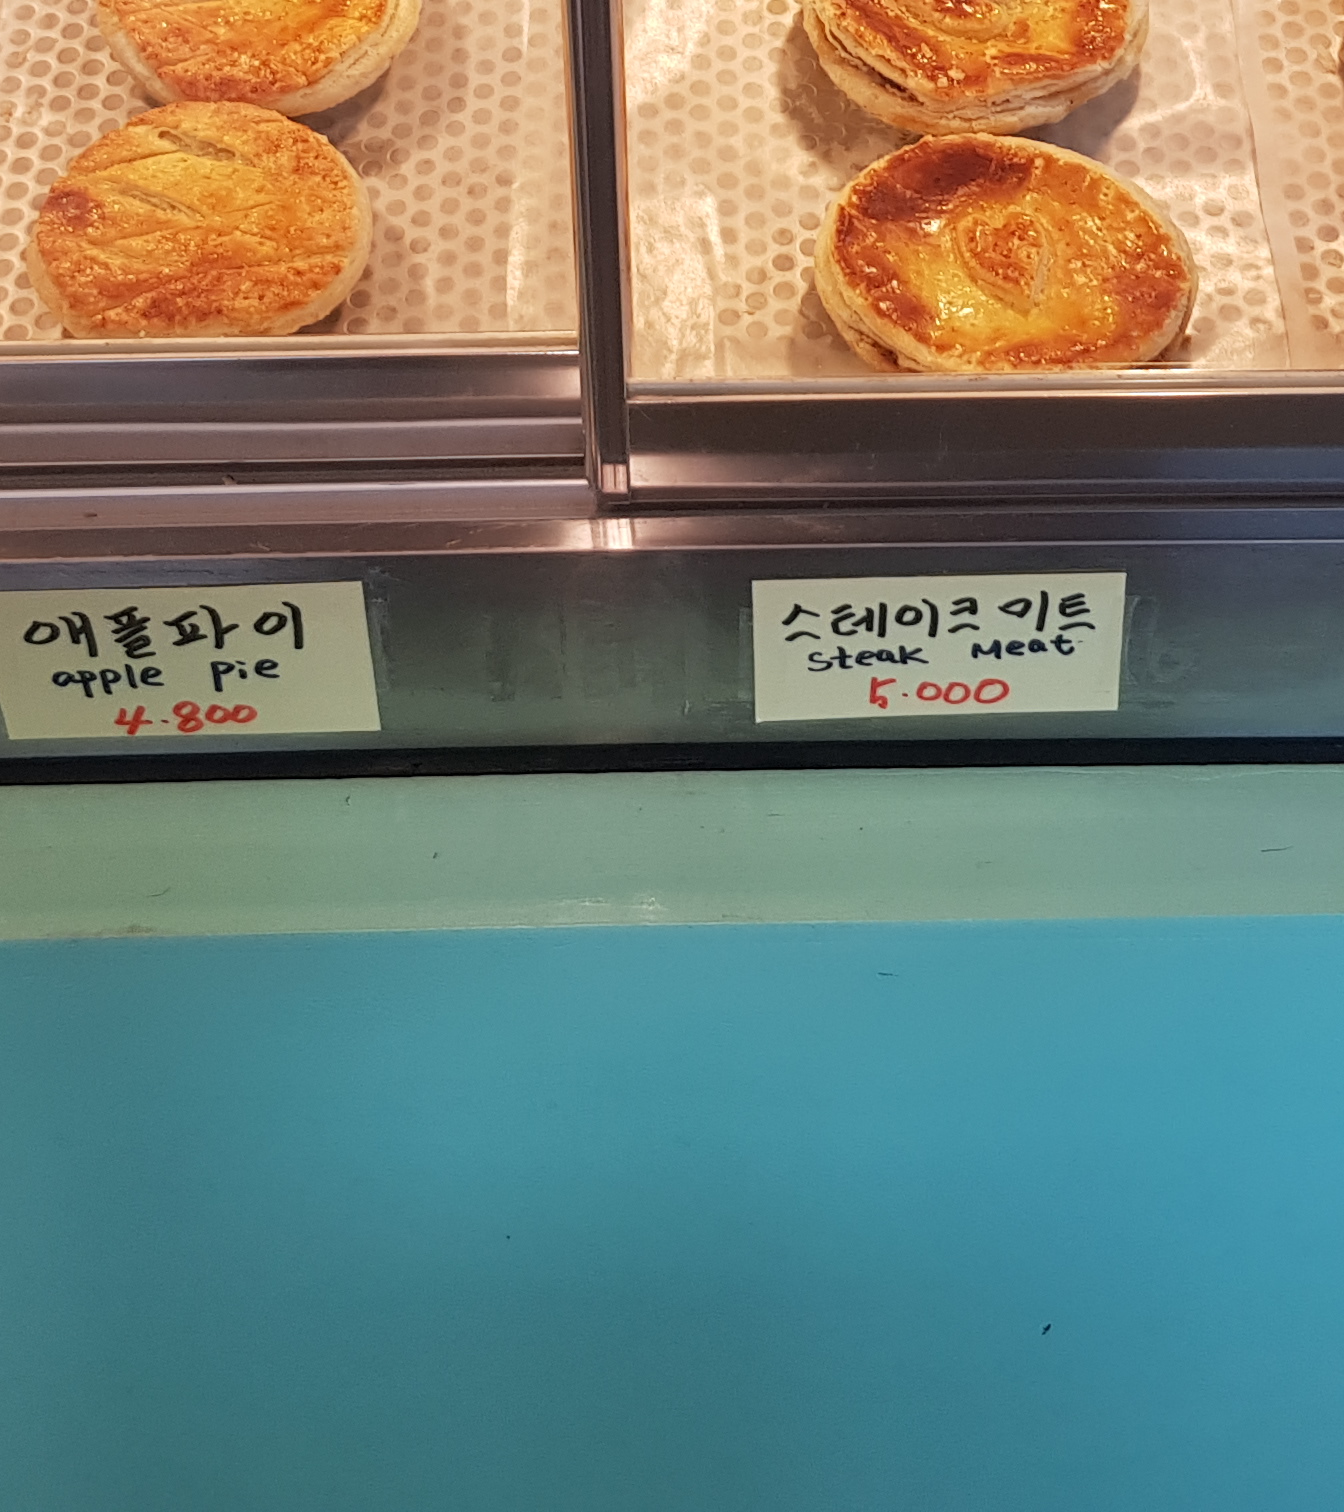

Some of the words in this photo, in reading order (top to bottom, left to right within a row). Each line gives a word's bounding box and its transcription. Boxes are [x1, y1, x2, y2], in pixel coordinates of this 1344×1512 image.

[23, 600, 304, 659] 애플파이
[970, 634, 1084, 661] Meat
[52, 663, 166, 699] apple
[868, 677, 1010, 710] 5.000
[114, 700, 258, 735] 4.800
